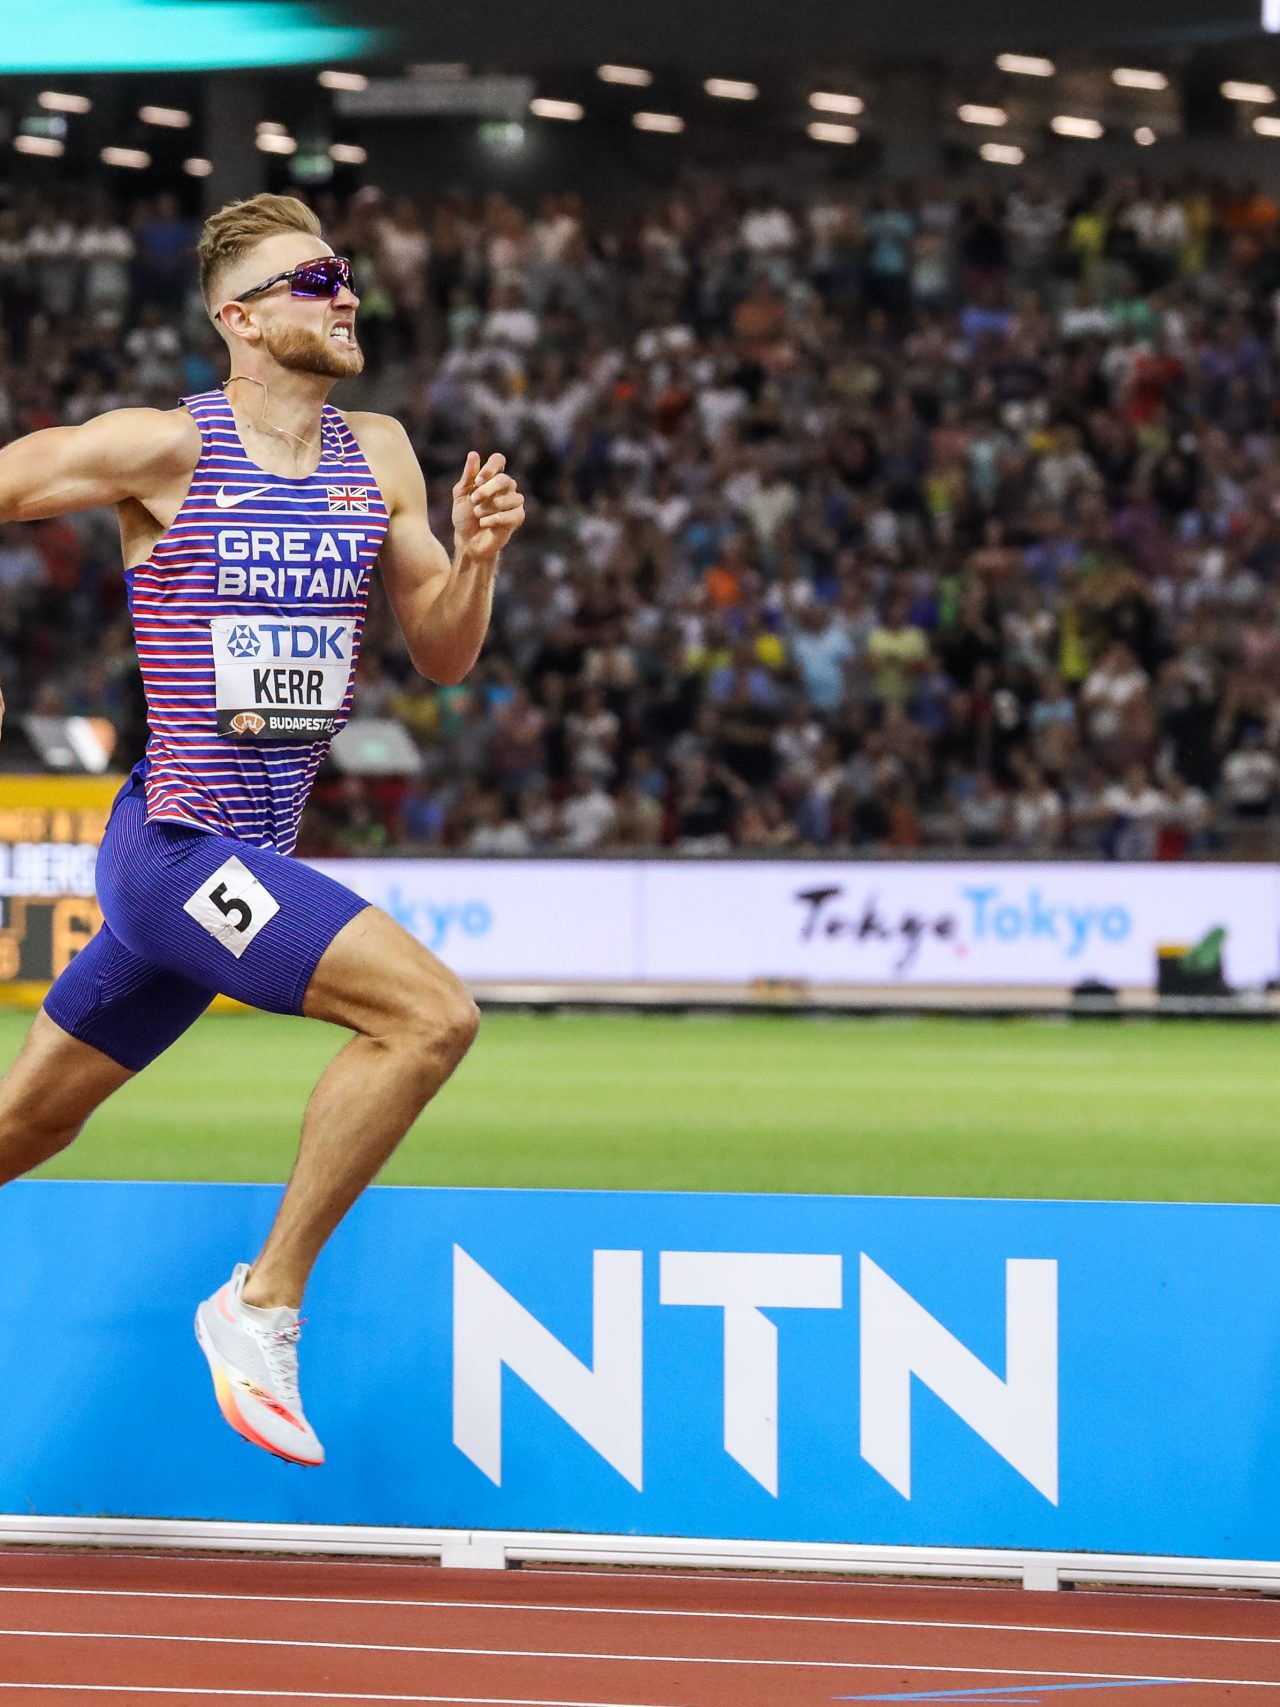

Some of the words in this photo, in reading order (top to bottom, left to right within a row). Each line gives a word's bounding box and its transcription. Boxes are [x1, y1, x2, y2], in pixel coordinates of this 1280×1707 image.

[217, 529, 366, 562] GREAT
[217, 565, 364, 598] BRITAIN
[259, 624, 347, 660] TDK
[253, 668, 324, 705] KERR
[208, 881, 253, 933] 5
[372, 884, 493, 951] kyo
[962, 885, 1133, 957] Tokyo
[453, 1242, 1059, 1508] NTN
